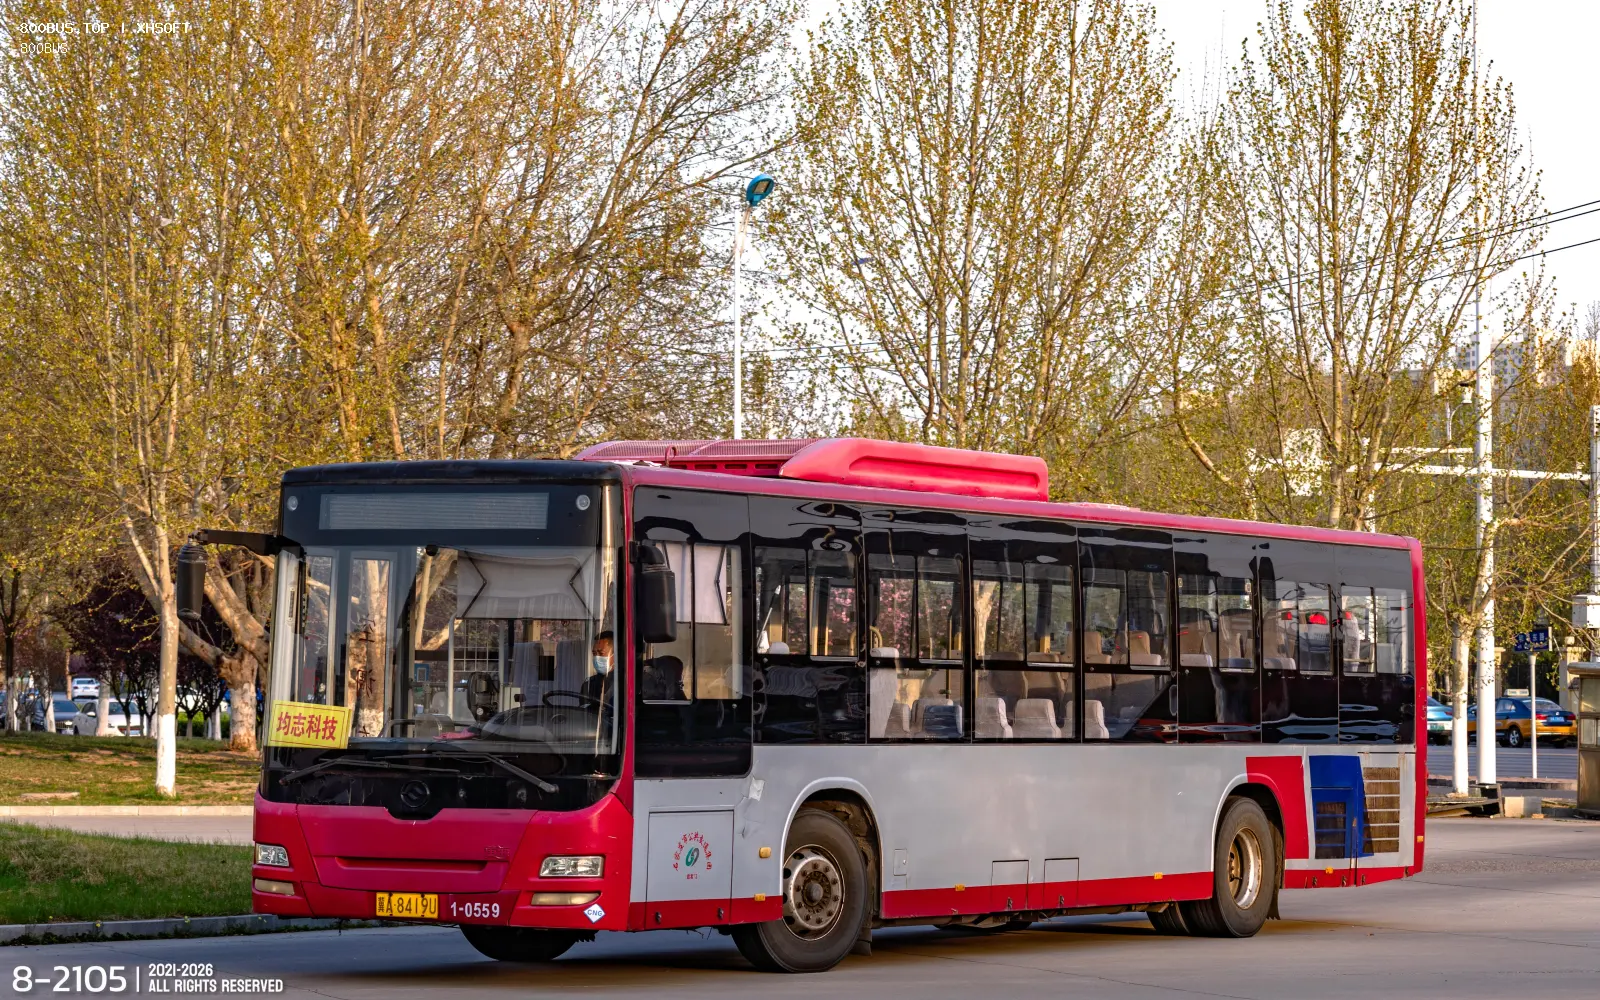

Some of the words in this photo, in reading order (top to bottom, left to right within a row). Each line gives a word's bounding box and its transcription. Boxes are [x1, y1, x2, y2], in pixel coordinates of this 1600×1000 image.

[276, 711, 338, 741] 均志科技
[450, 901, 500, 918] 1-0559
